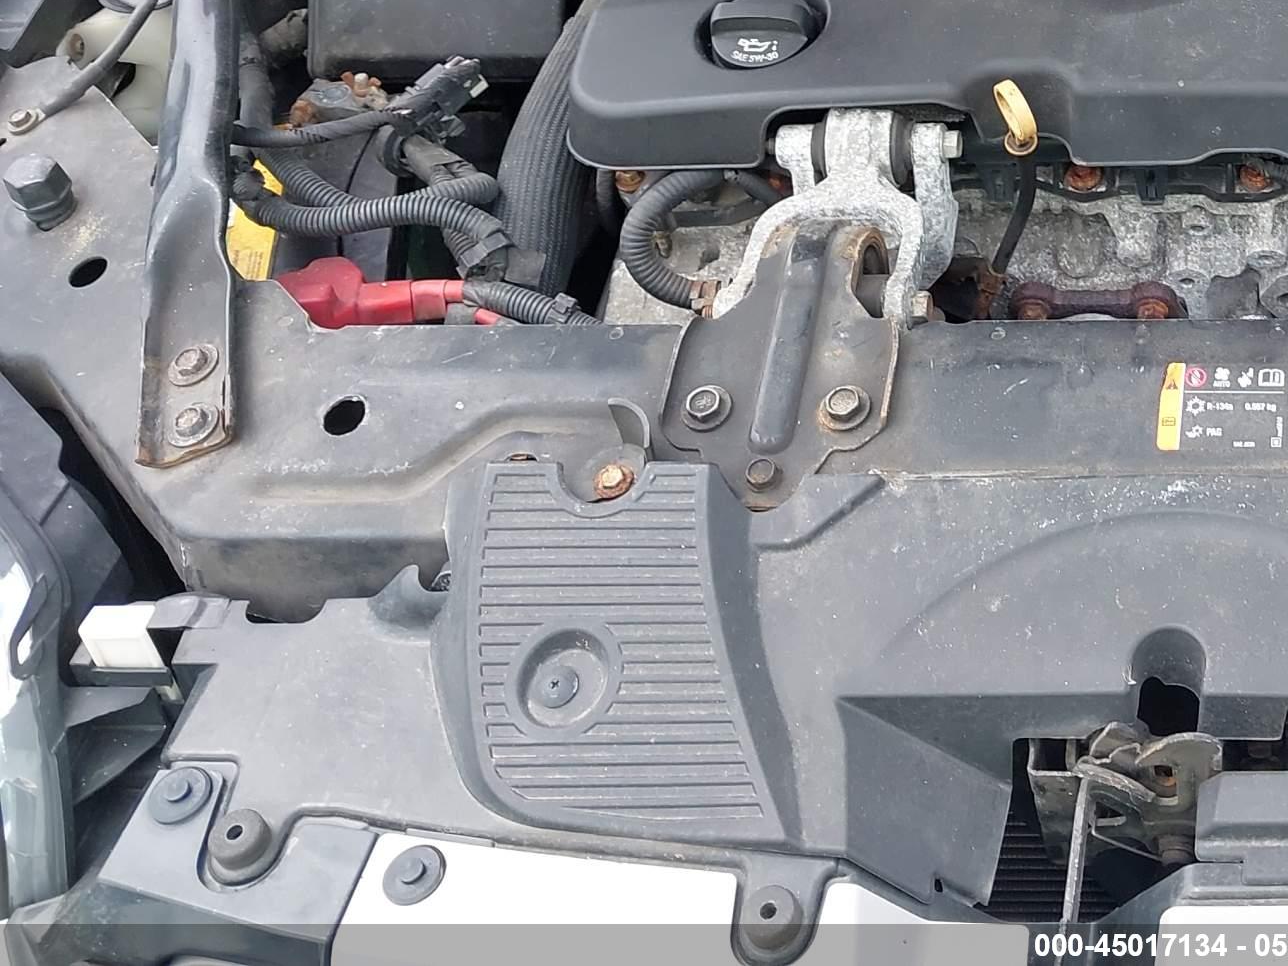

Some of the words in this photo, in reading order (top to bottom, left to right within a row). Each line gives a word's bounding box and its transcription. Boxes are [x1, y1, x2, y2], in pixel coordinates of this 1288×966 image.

[731, 50, 750, 62] SAE
[748, 51, 779, 63] 5W-30
[1213, 380, 1231, 388] AUTO
[1206, 402, 1234, 411] R-134a
[1266, 403, 1277, 412] kg
[1206, 427, 1222, 437] PAG
